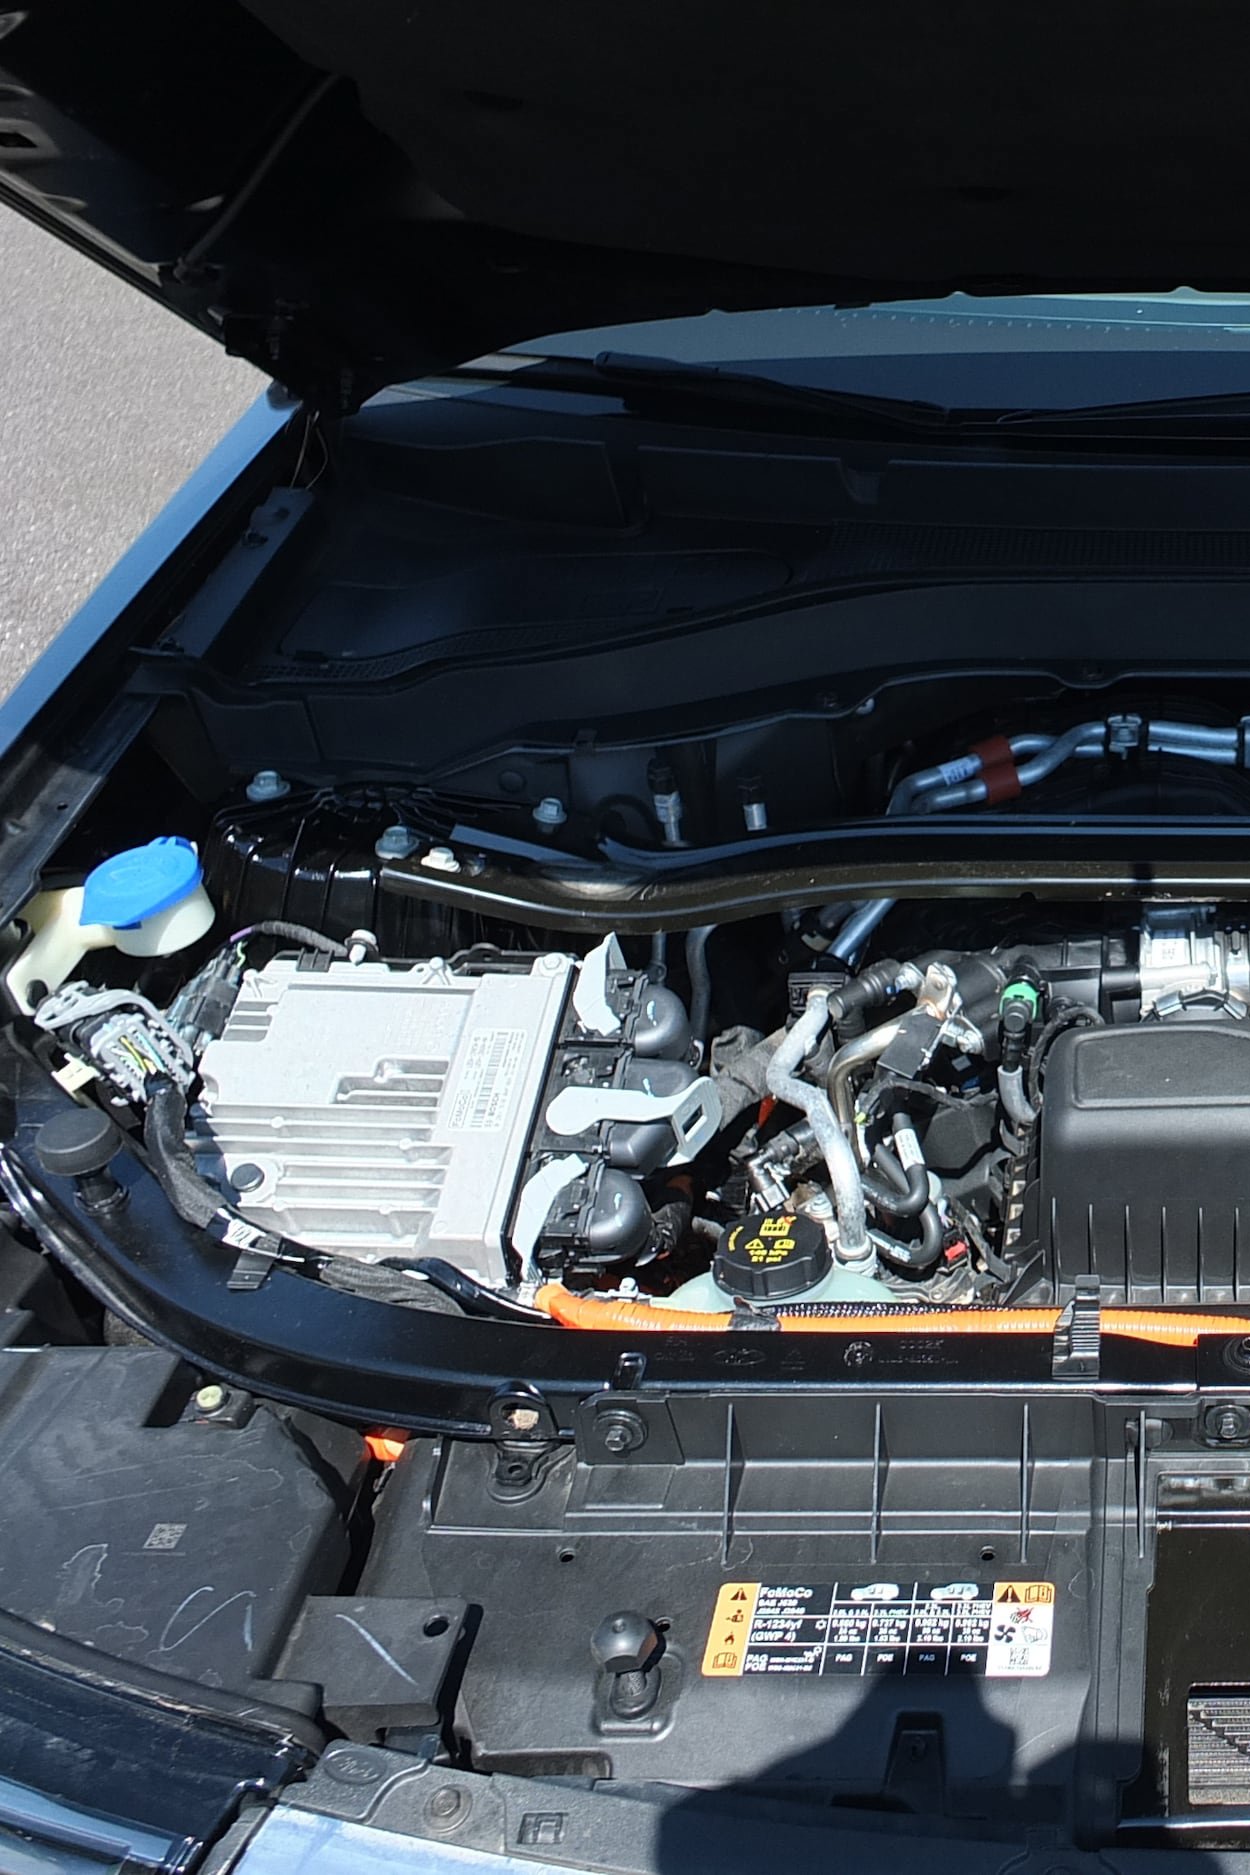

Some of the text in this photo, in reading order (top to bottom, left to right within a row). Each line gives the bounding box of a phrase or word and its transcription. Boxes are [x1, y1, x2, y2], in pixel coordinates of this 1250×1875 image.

[759, 1586, 813, 1598] FoMoCo
[754, 1619, 803, 1630] R-1234yf
[895, 1619, 906, 1629] kg
[938, 1618, 949, 1629] kg
[978, 1618, 989, 1629] kg
[751, 1632, 796, 1642] (GWP 4)
[746, 1654, 768, 1662] PAG
[835, 1653, 853, 1663] PAG
[877, 1653, 894, 1663] POE
[919, 1654, 935, 1662] PAG
[960, 1654, 978, 1662] POE
[745, 1662, 767, 1671] POE
